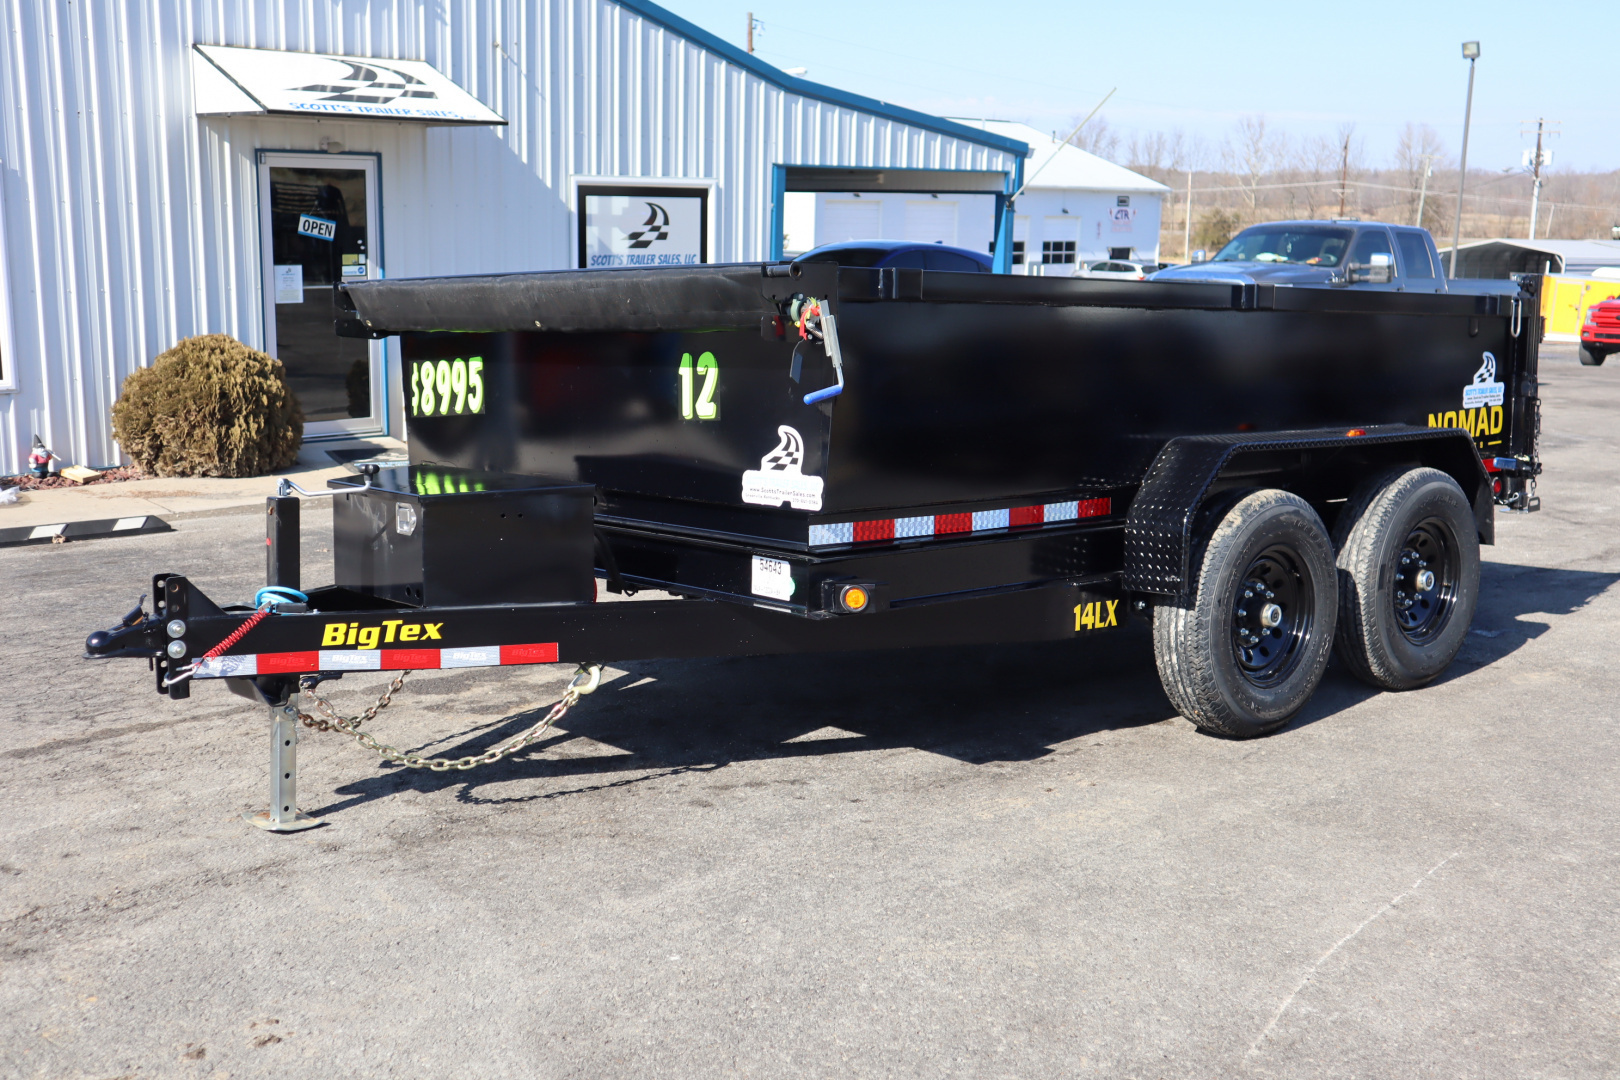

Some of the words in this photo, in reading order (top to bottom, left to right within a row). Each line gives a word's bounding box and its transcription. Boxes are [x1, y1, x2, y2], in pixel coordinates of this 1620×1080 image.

[289, 102, 352, 113] SCOTT'S
[357, 105, 412, 116] TRAILER
[303, 219, 333, 237] OPEN
[591, 254, 624, 266] SCOTT'S
[626, 253, 656, 266] TRAILER
[684, 253, 697, 265] LLC
[411, 356, 484, 416] $8995
[678, 351, 718, 420] 12
[1428, 406, 1503, 437] NOMAD
[759, 558, 782, 576] 54643
[1073, 599, 1119, 632] 14LX
[321, 619, 444, 650] BigTex
[331, 654, 369, 664] BigTex
[452, 651, 488, 661] BigTex
